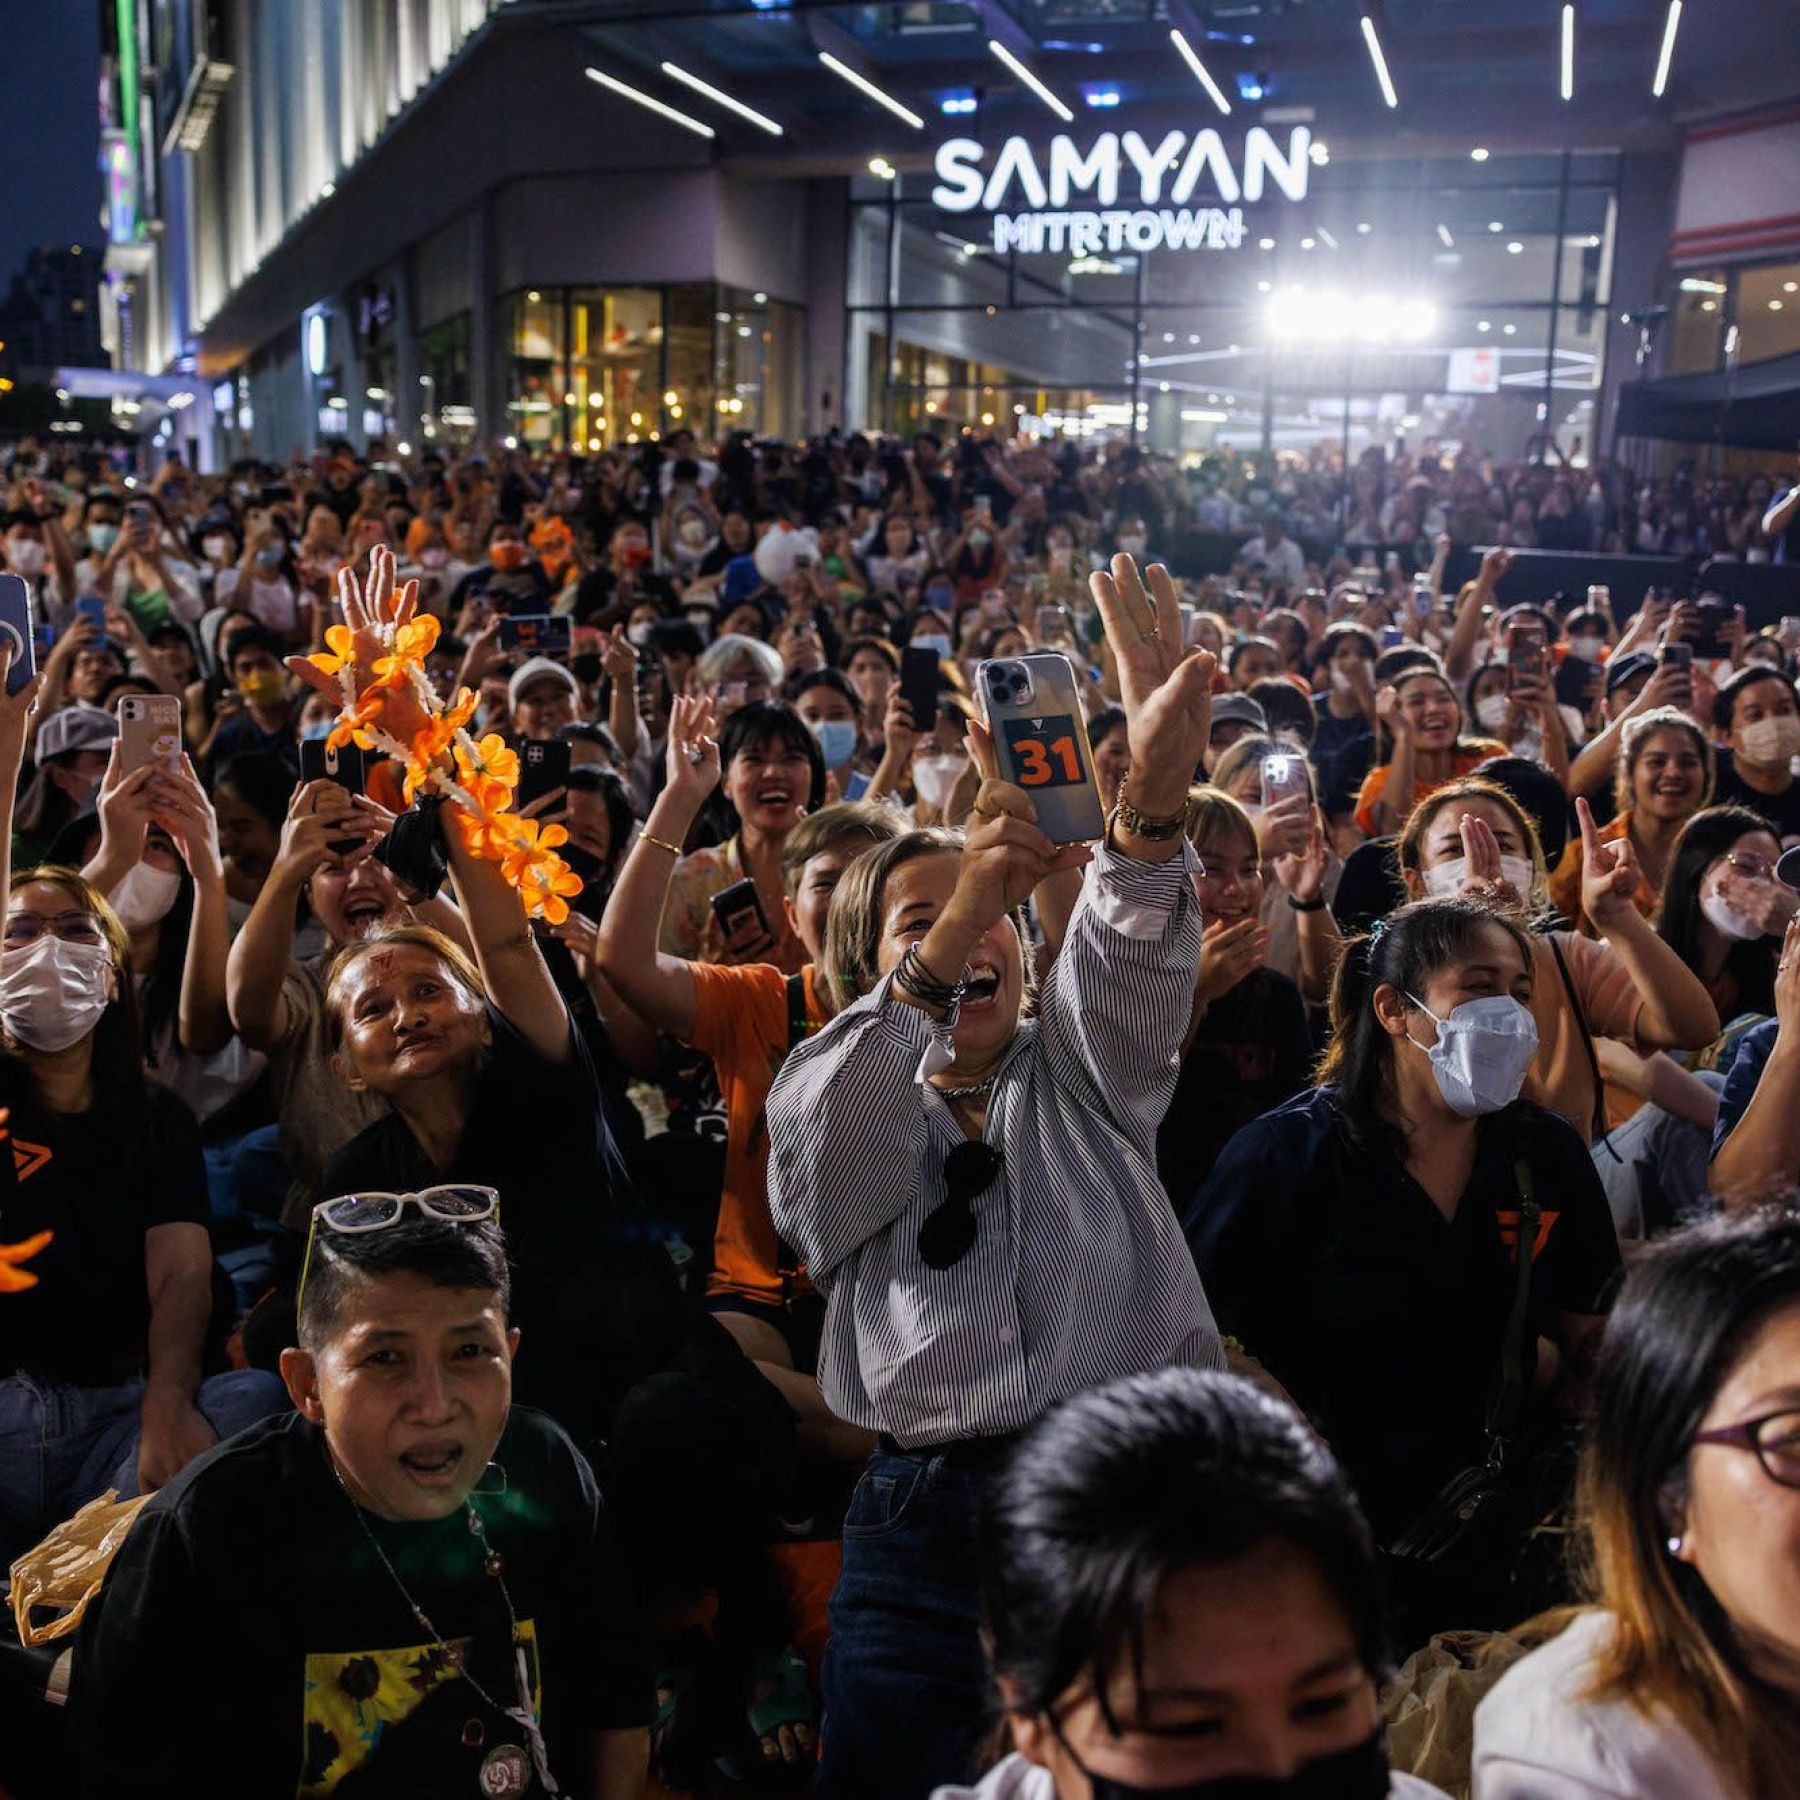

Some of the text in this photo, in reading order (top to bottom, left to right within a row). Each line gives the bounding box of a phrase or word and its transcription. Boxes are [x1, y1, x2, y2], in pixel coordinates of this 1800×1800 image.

[932, 126, 1311, 212] SAMYAN
[993, 208, 1244, 253] MITRTOWN
[1012, 735, 1081, 785] 31
